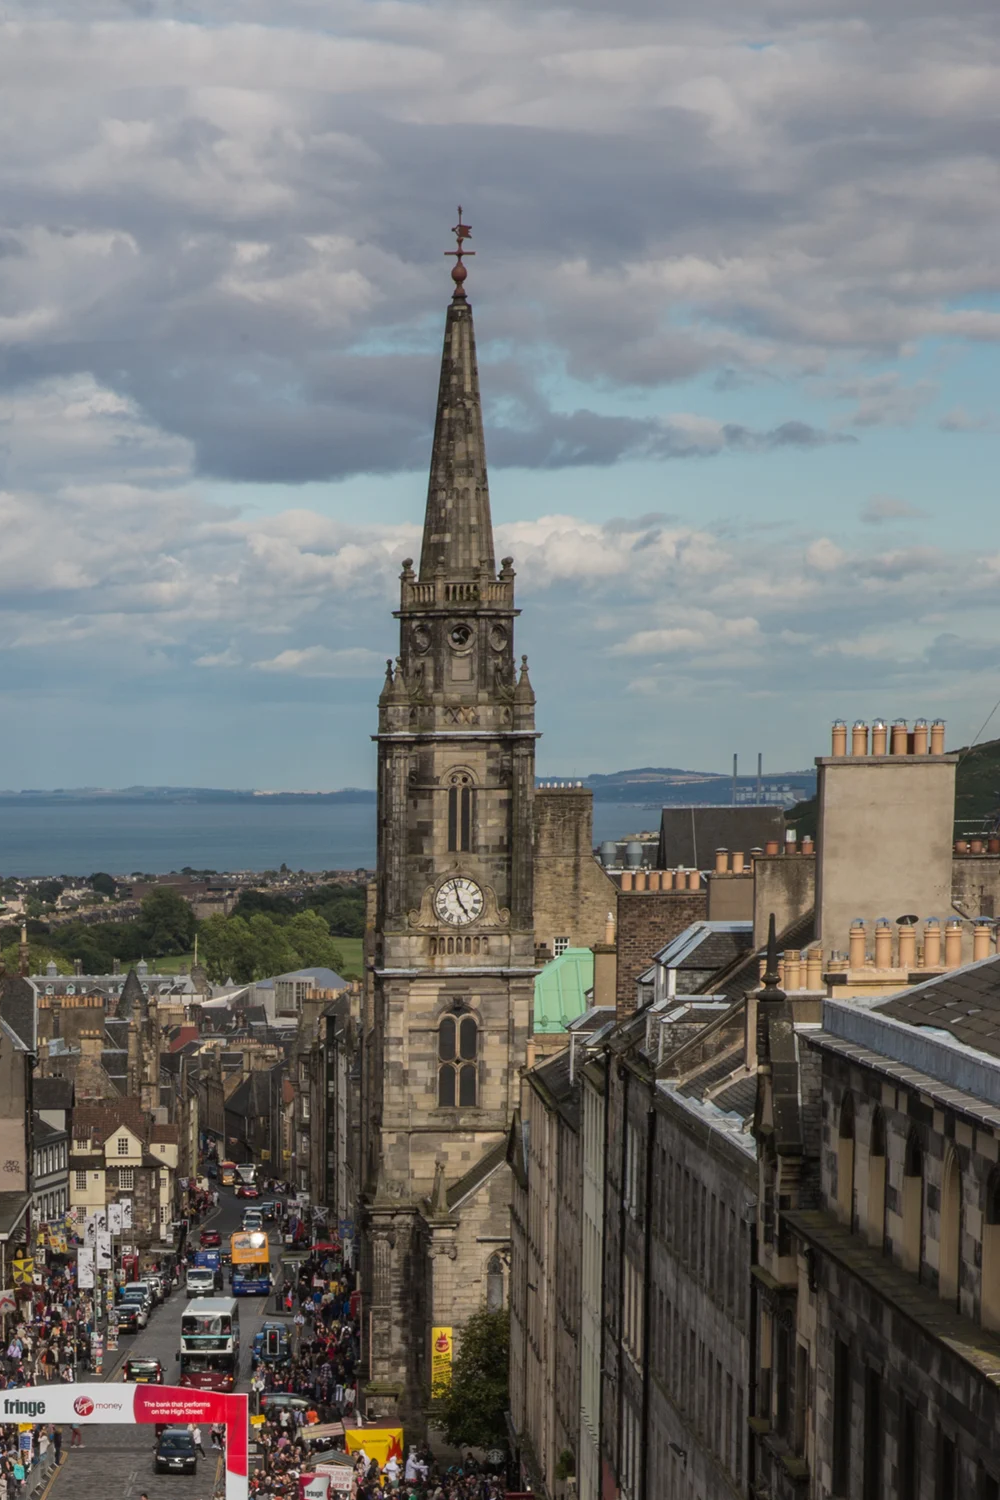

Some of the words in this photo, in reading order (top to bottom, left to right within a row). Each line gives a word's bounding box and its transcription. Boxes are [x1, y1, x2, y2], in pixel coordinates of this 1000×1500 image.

[4, 1399, 45, 1417] fringe
[75, 1398, 93, 1415] Virgin
[95, 1402, 123, 1411] money
[184, 1401, 211, 1409] performs
[171, 1408, 184, 1416] High
[306, 1489, 324, 1498] fringe
